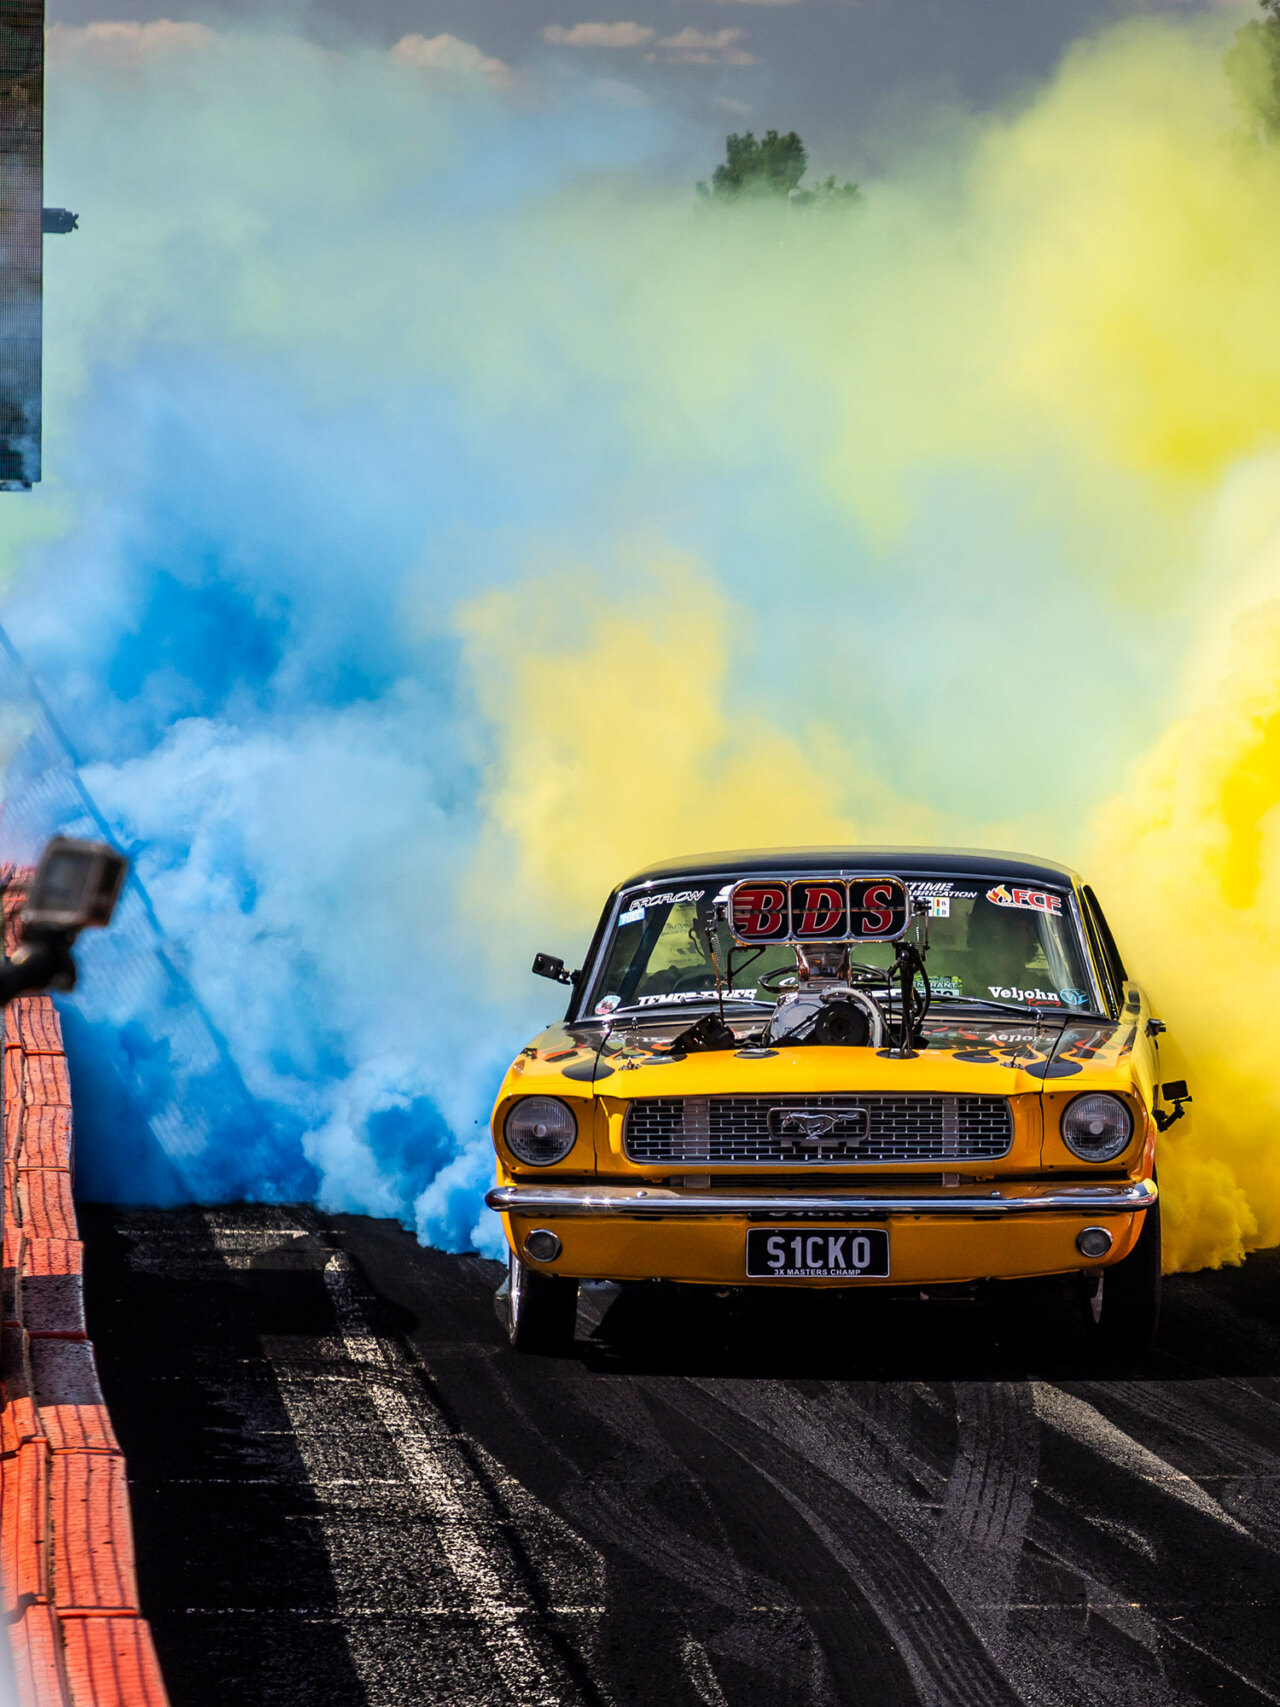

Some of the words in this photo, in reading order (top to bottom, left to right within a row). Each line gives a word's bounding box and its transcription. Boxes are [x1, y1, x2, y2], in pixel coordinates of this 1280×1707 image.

[629, 890, 705, 911] PROFLOW
[908, 889, 977, 899] BRICATION
[1012, 888, 1062, 911] FCF
[733, 885, 893, 936] BDS
[988, 986, 1060, 1002] Veljohn
